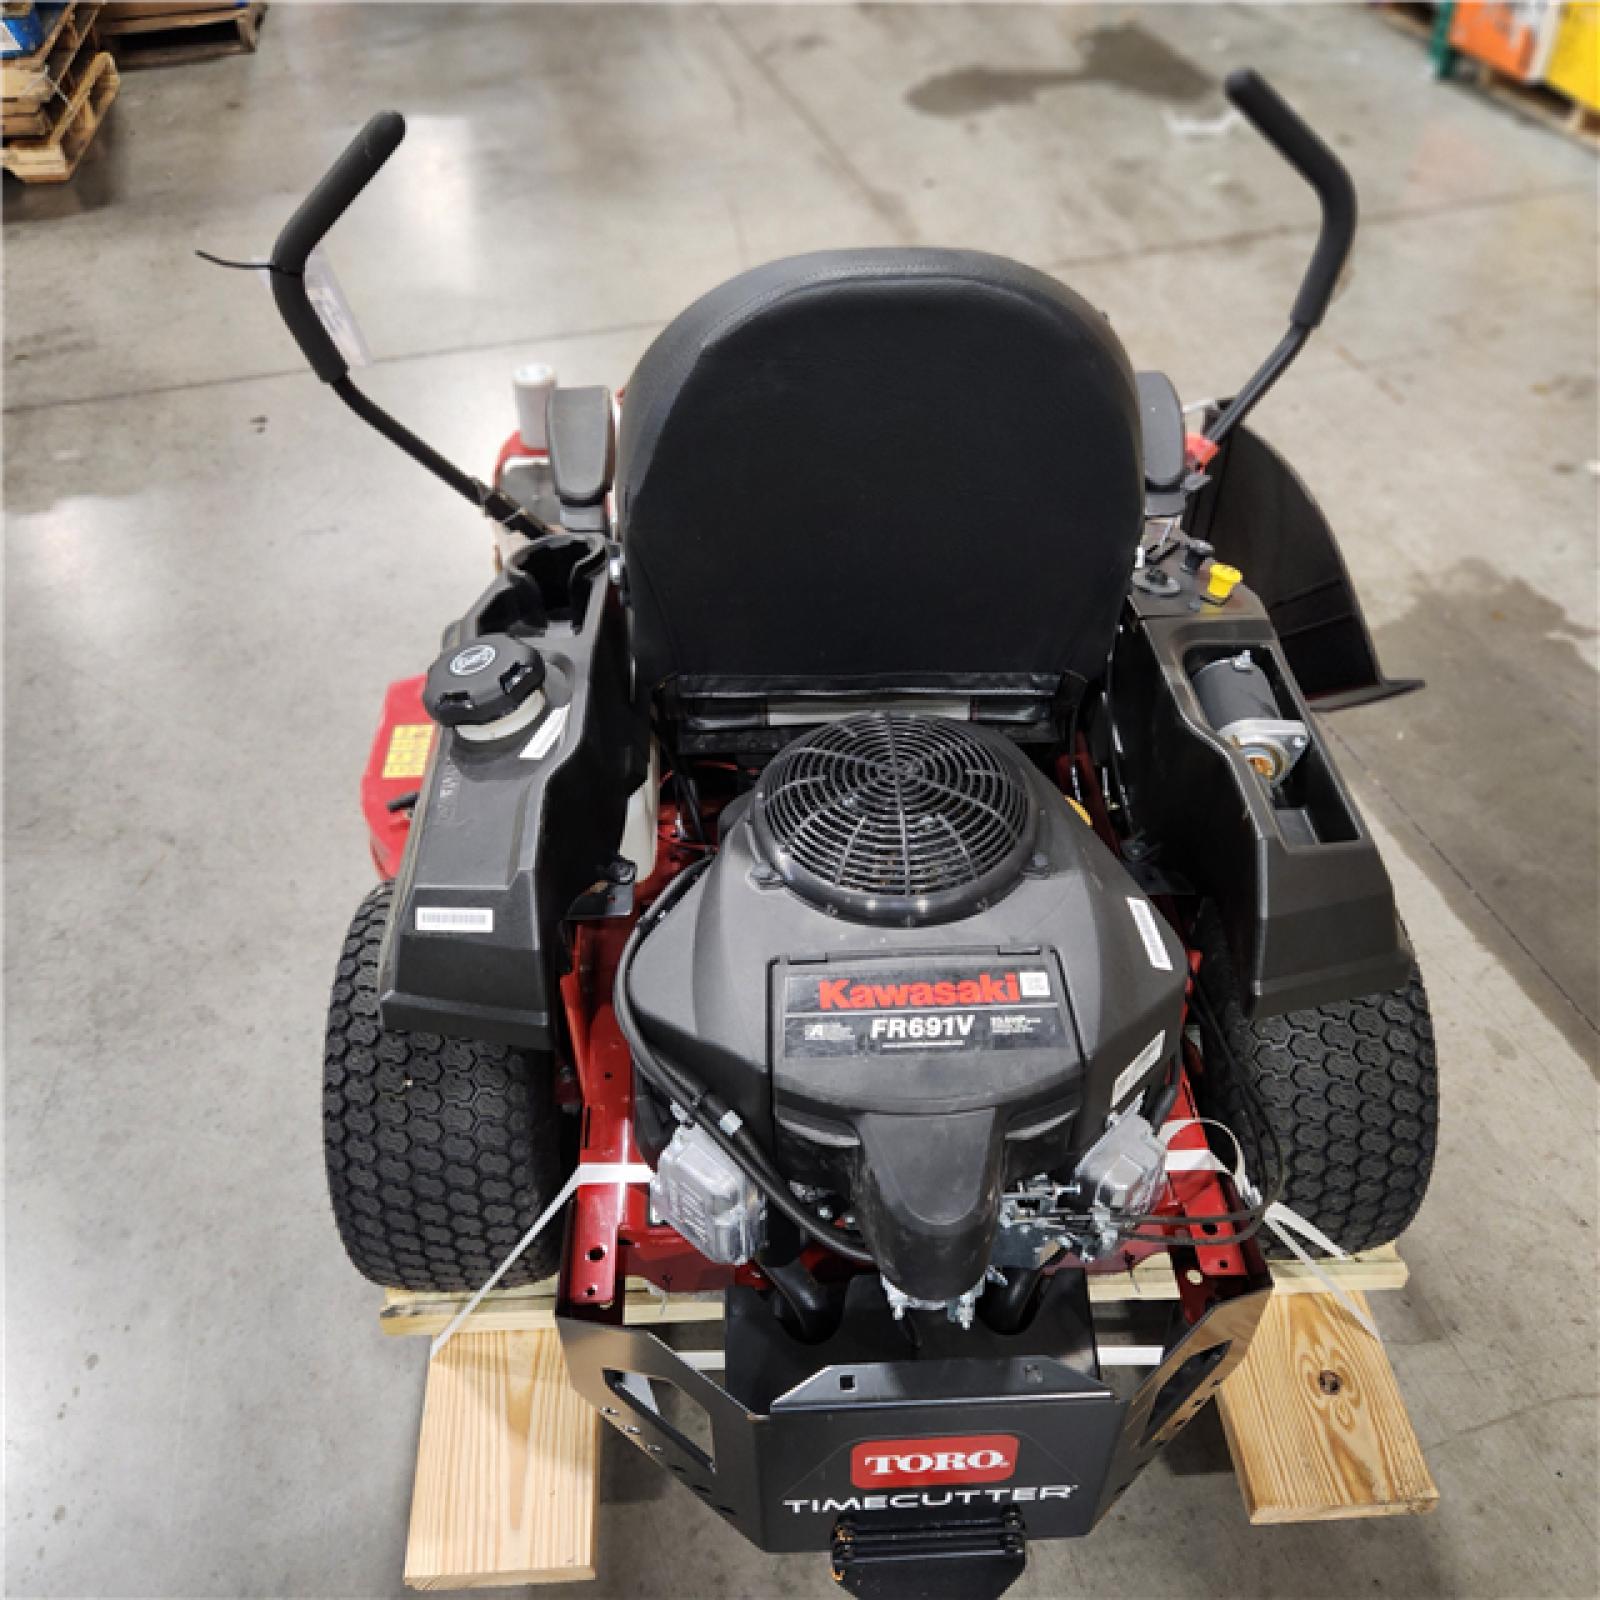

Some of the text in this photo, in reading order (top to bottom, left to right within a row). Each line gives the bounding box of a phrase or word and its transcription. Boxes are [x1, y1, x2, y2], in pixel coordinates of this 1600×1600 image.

[818, 973, 1020, 1010] Kawasaki
[869, 1014, 975, 1039] FR691V
[864, 1449, 1006, 1475] TORO
[782, 1485, 1074, 1513] TIMECUTTER
